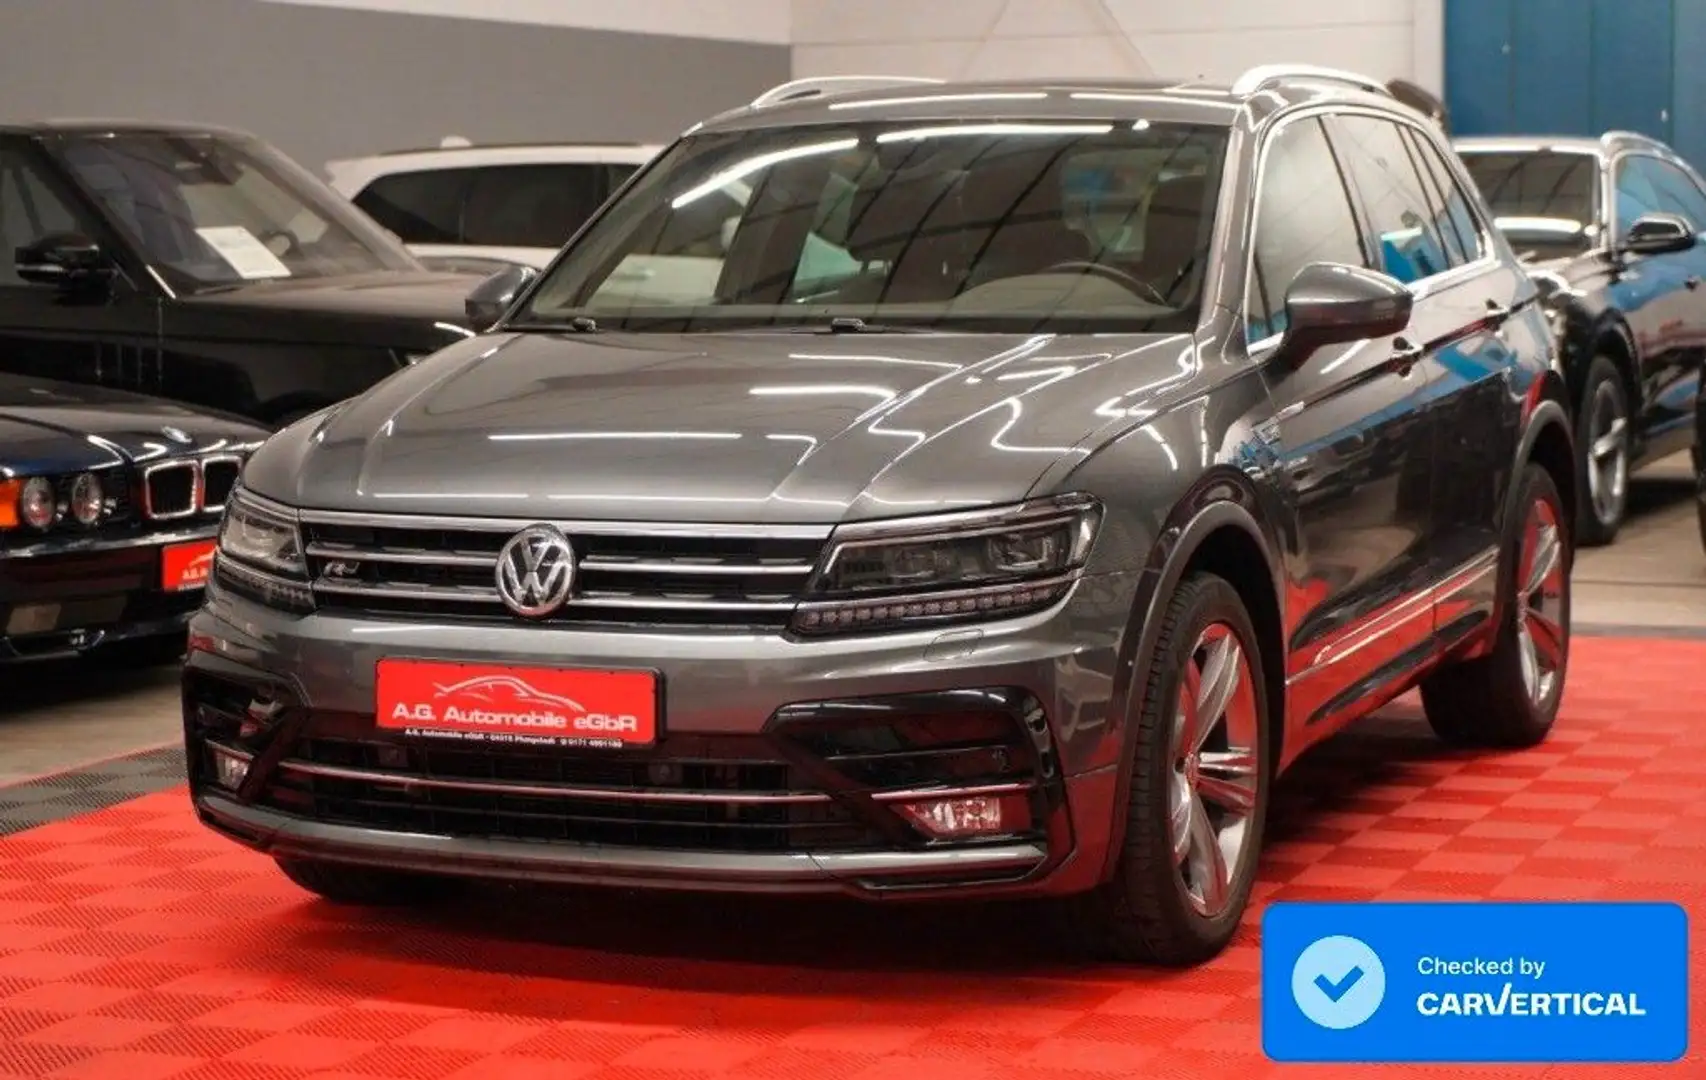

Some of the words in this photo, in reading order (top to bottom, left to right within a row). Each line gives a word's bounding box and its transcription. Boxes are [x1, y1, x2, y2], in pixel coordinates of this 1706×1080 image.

[498, 524, 574, 614] VW
[393, 702, 436, 721] A.G.
[444, 705, 567, 729] Automobile
[573, 713, 637, 732] eGbR
